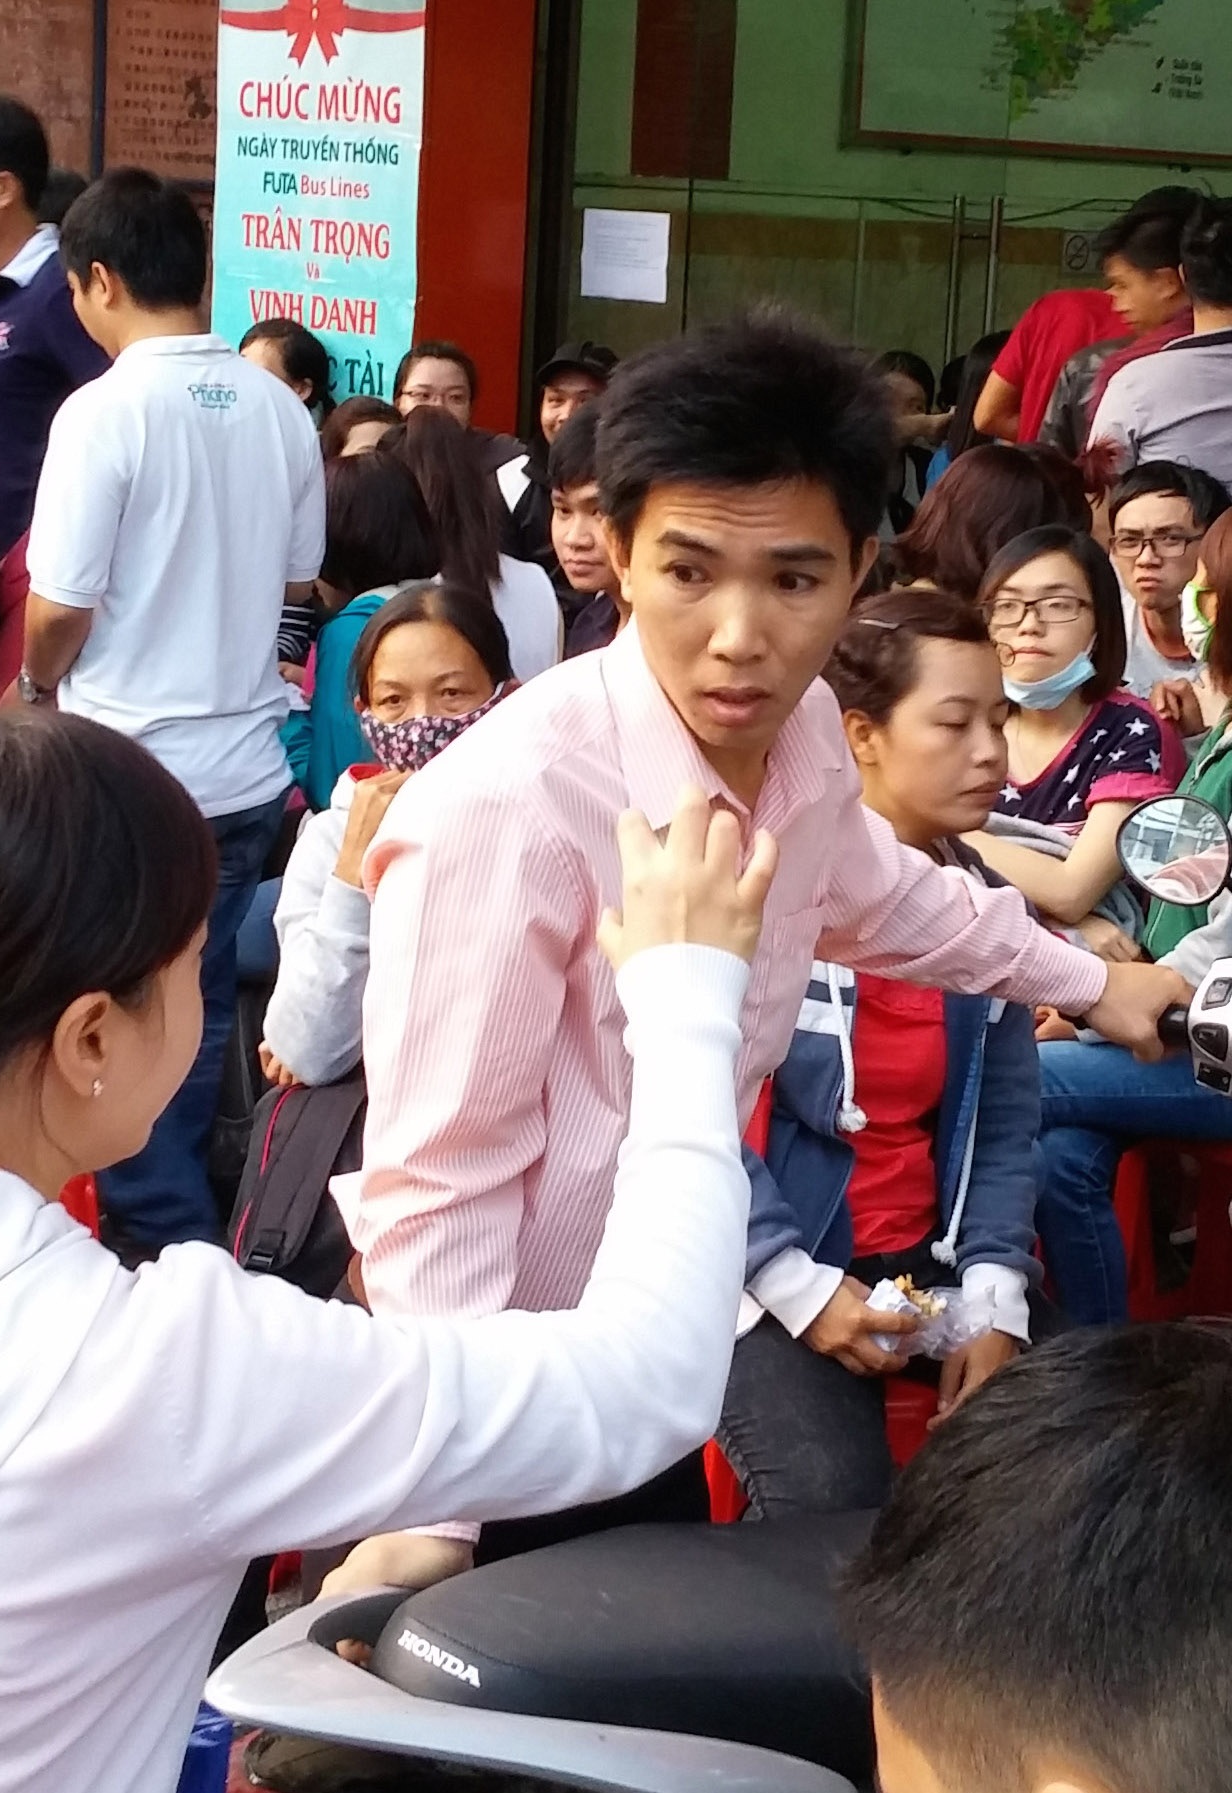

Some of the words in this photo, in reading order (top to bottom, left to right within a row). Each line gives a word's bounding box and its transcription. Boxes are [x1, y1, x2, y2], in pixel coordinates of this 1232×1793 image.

[240, 75, 309, 120] CHÚC
[318, 77, 400, 124] MỪNG
[237, 133, 278, 158] NGÀY
[263, 171, 297, 194] FUTA
[301, 175, 326, 196] Bus
[330, 177, 369, 199] Lines
[242, 206, 301, 251] TRÂN
[310, 219, 390, 263] TRỌNG
[250, 290, 303, 327] VINH
[311, 296, 377, 335] DANH
[345, 349, 384, 396] TÀI
[397, 1629, 481, 1688] HONDA
